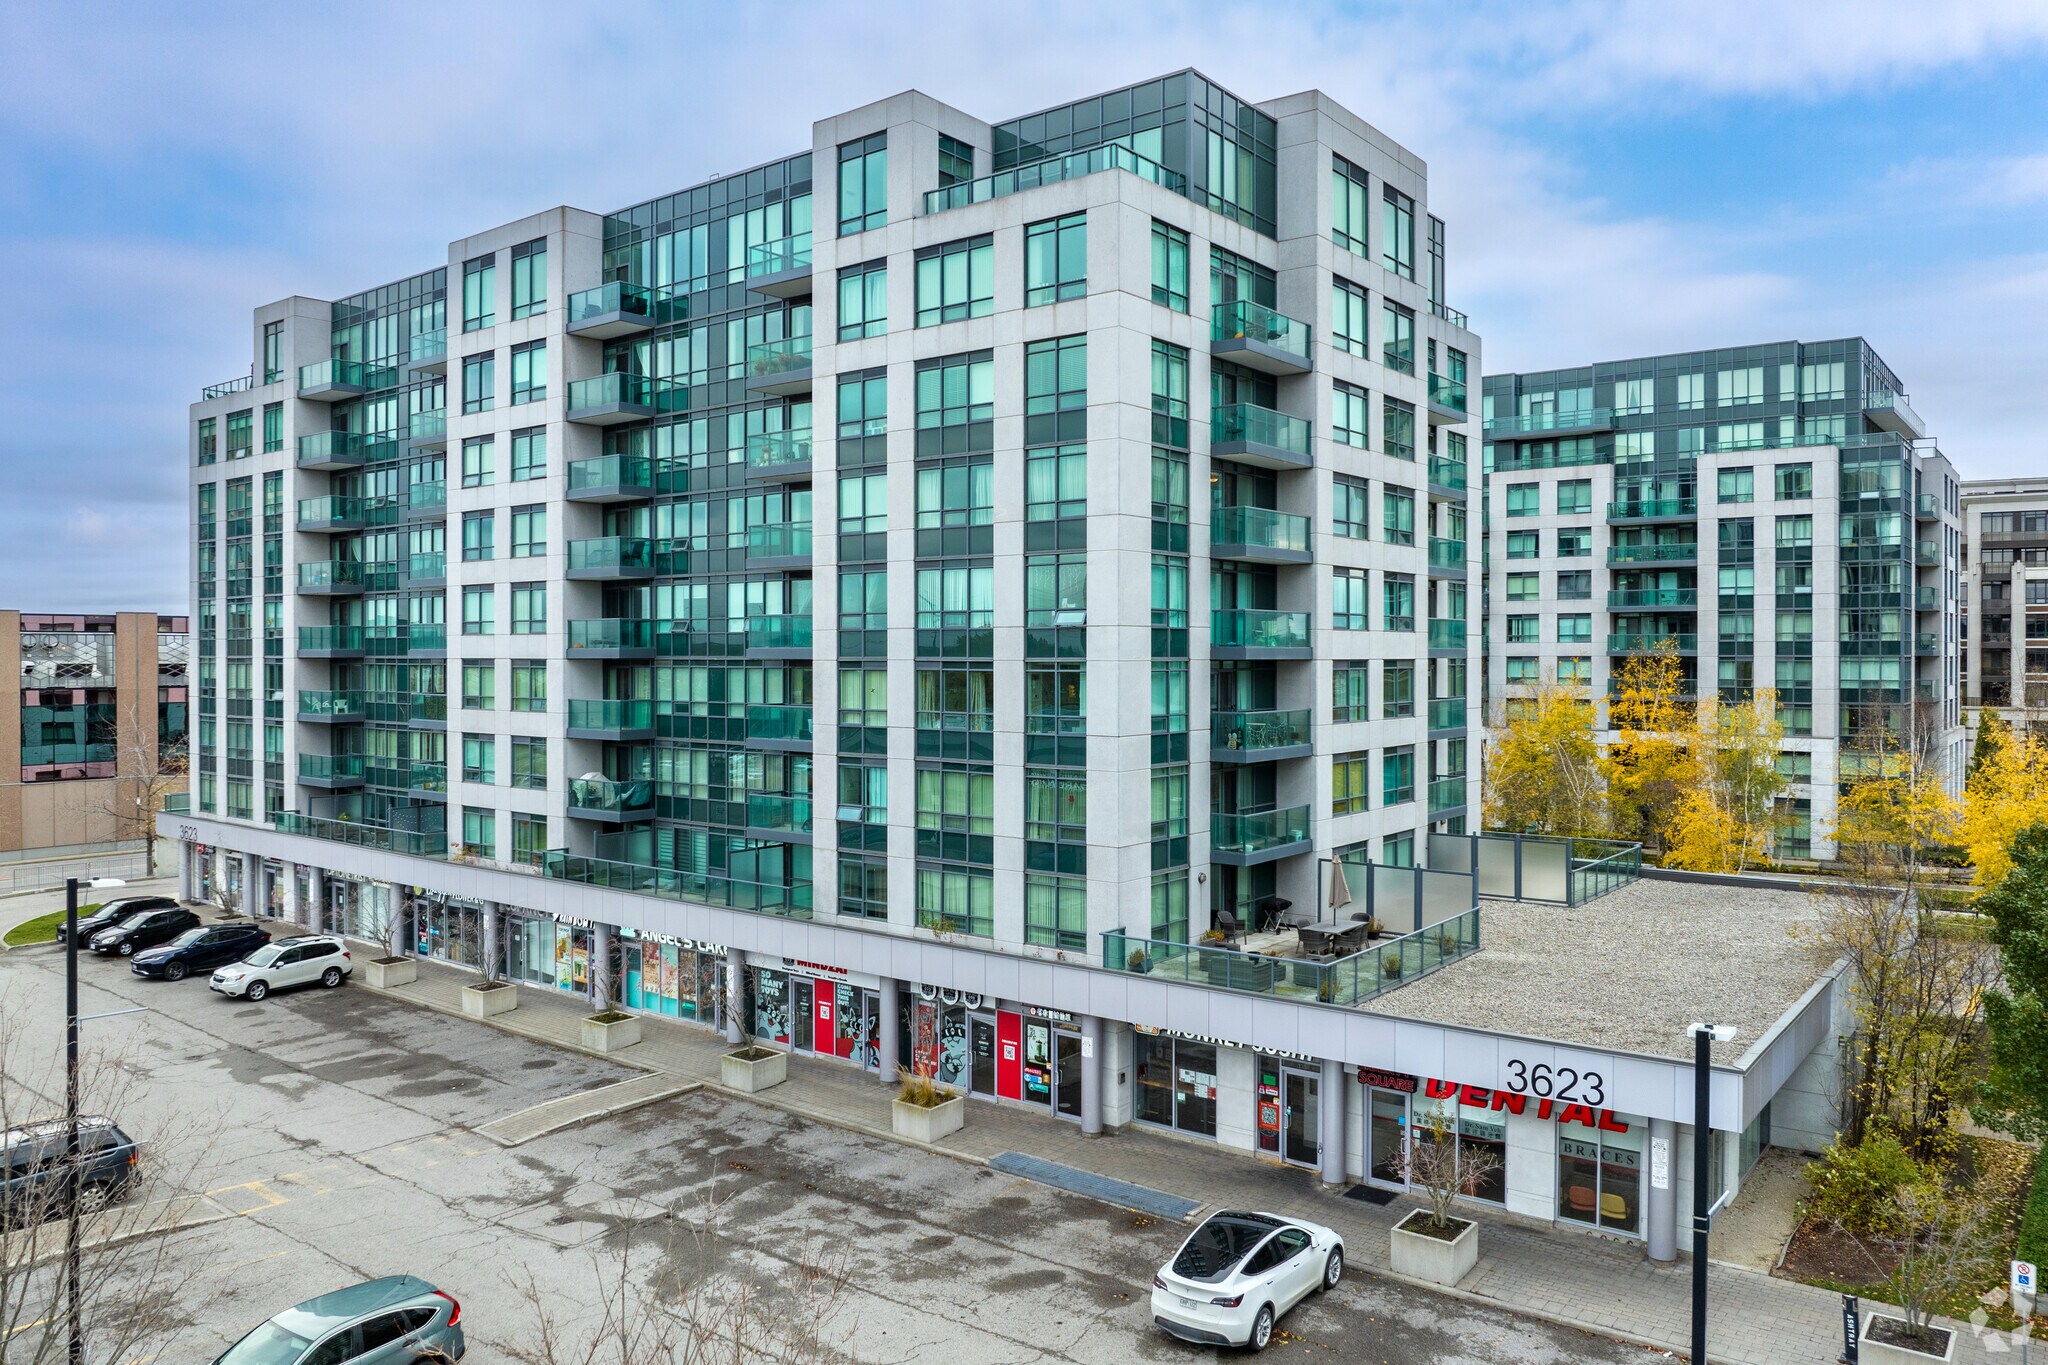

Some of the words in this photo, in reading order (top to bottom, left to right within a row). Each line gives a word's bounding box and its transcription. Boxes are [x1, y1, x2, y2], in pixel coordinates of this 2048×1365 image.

[180, 825, 198, 841] 3623
[641, 930, 693, 949] ANGEL'S
[761, 970, 771, 978] SO
[761, 978, 783, 990] MANY
[761, 986, 780, 997] TOYS
[1359, 1071, 1414, 1092] SQUARE
[1506, 1059, 1605, 1106] 3623
[1425, 1077, 1629, 1134] DENTAL
[1564, 1143, 1634, 1166] BRACES
[1847, 1313, 1856, 1348] ASHTRAY
